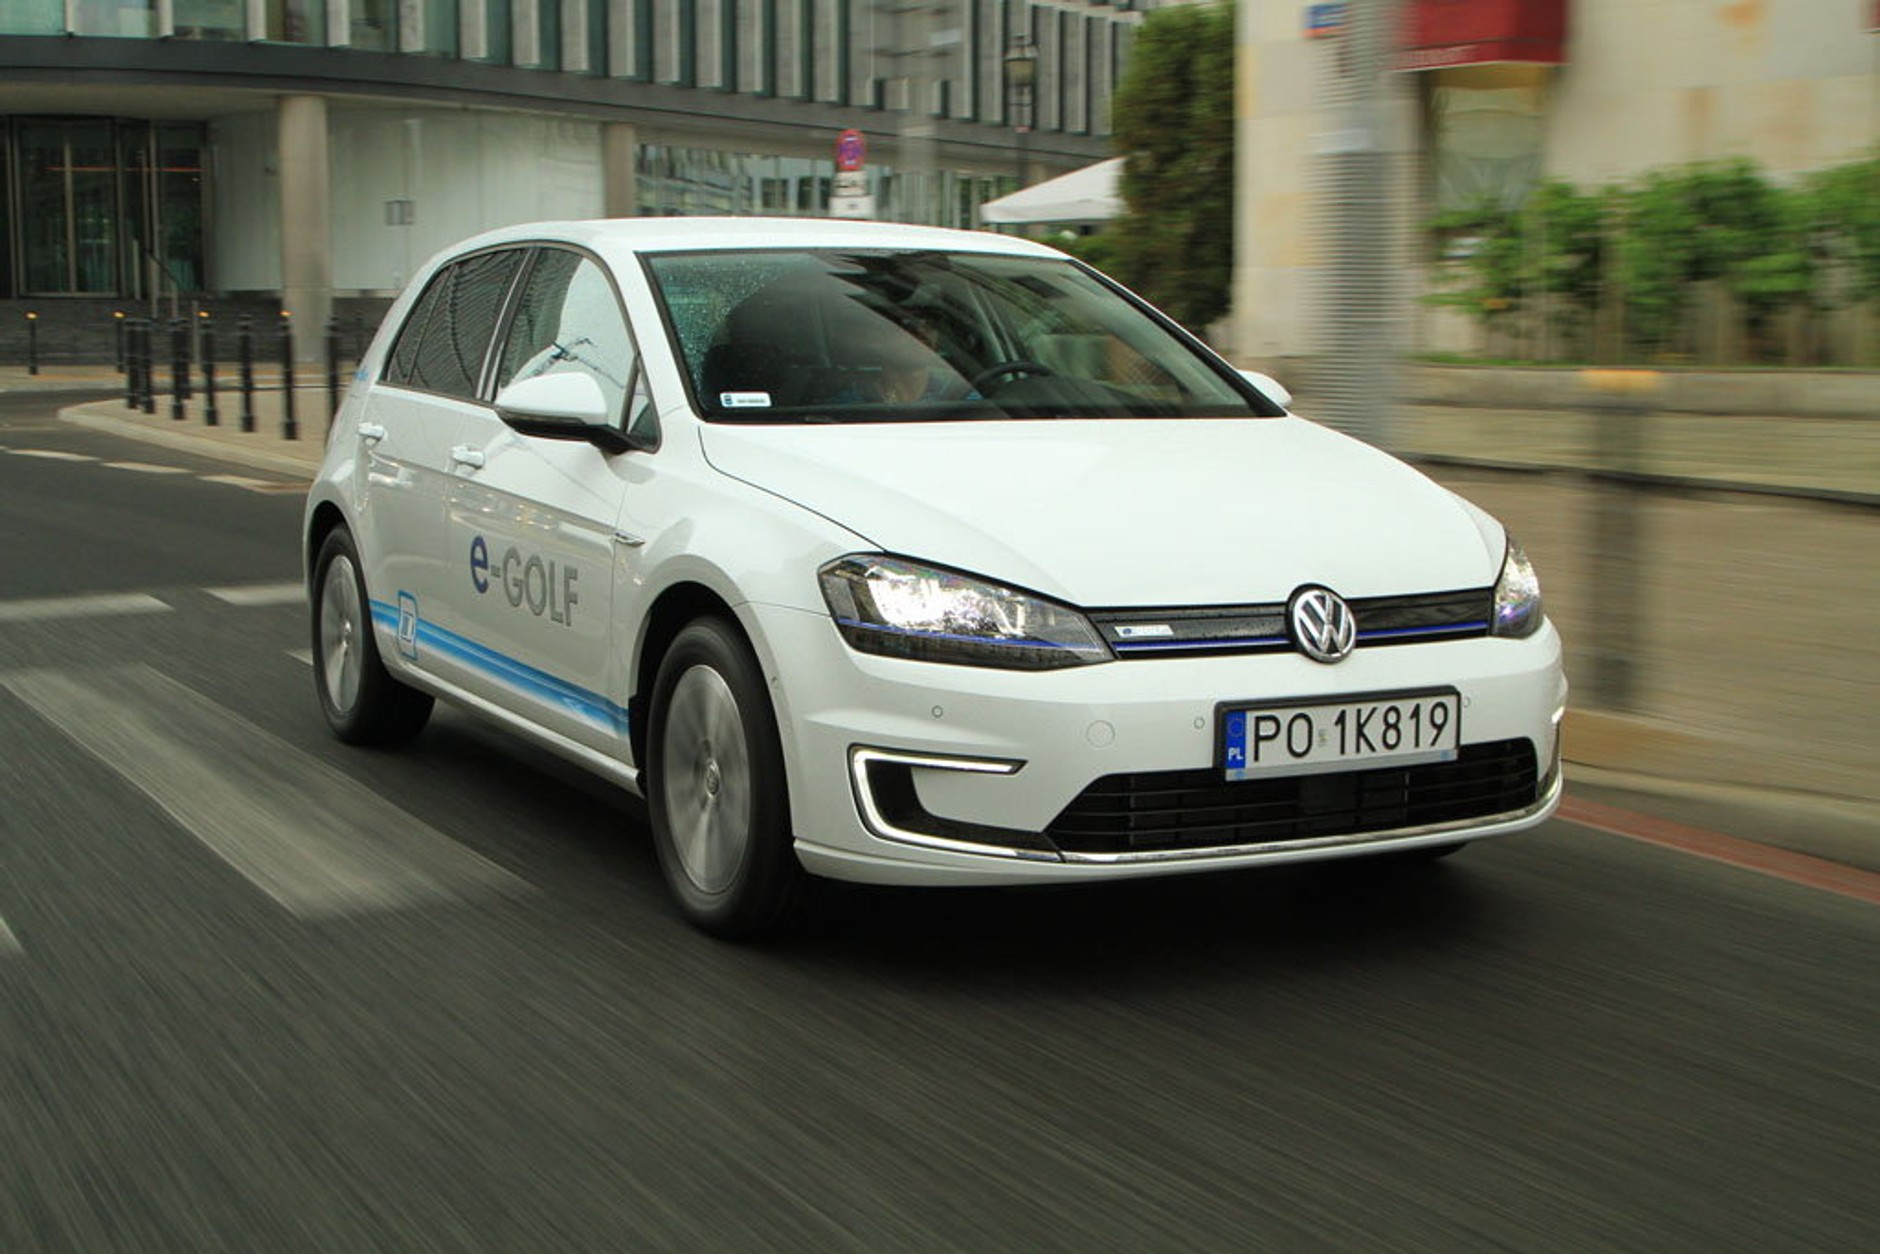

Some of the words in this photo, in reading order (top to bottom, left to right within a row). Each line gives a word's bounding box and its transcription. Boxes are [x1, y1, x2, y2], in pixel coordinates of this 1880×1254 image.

[470, 535, 578, 627] e-GOLF
[1228, 745, 1244, 760] PL
[1253, 712, 1314, 762] PO
[1334, 701, 1449, 755] 1K819
